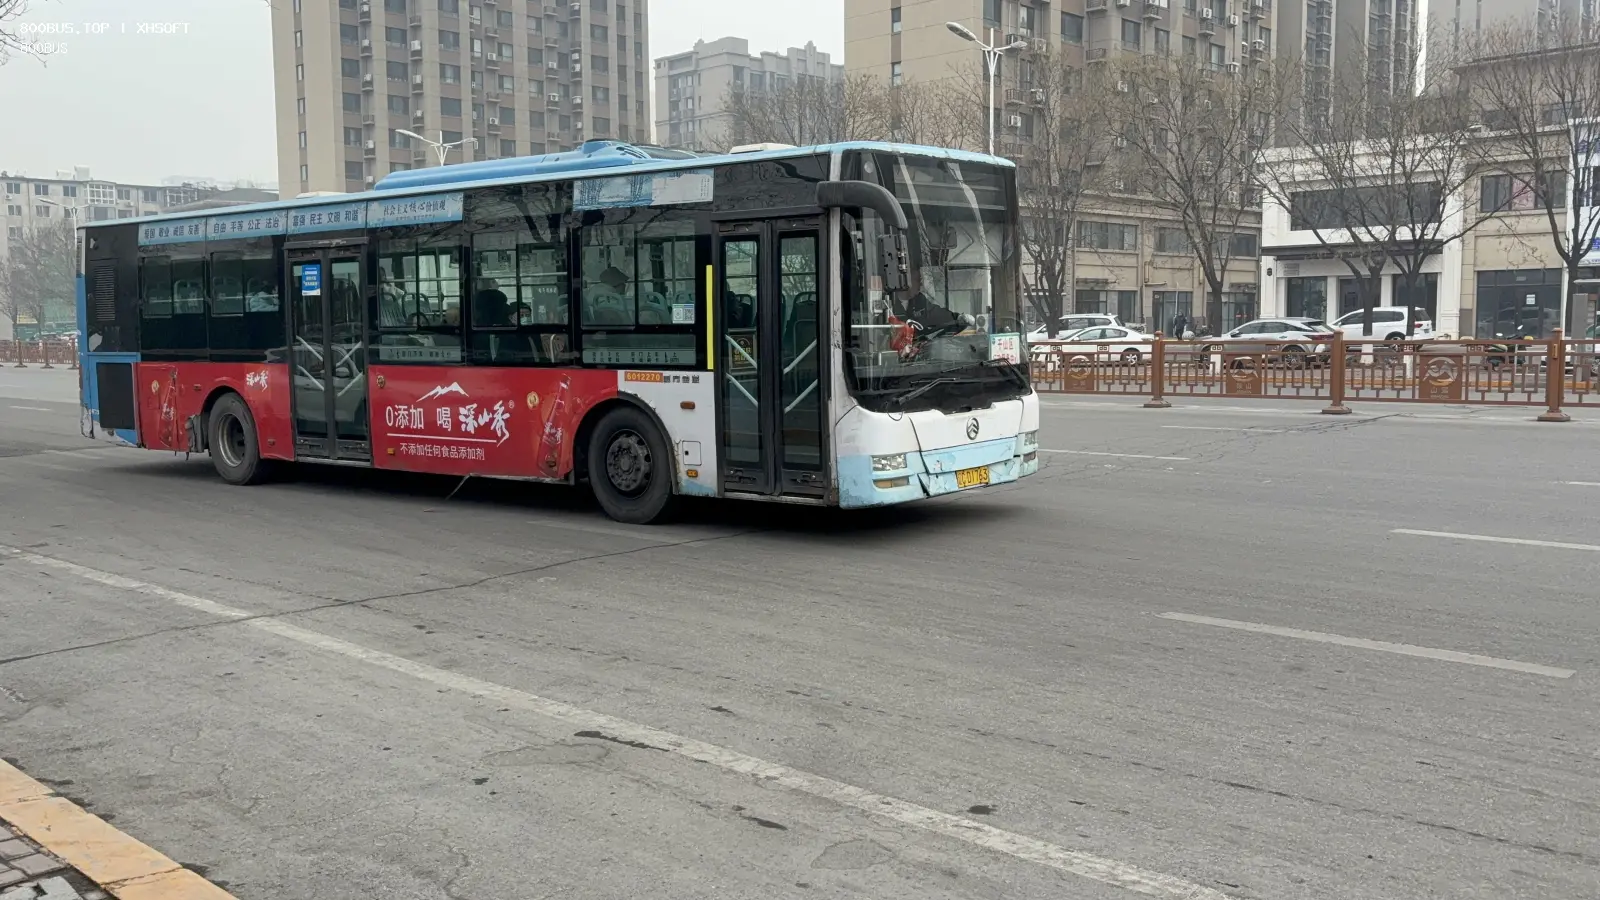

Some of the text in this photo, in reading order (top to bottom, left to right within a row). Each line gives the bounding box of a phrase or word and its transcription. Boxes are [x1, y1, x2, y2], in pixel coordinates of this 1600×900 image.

[383, 200, 446, 216] 社会主义核心价值观
[213, 216, 279, 233] 自由 平等 公正 法治
[292, 208, 358, 227] 富强 民主 文明 和谐
[158, 226, 170, 237] 敬业
[188, 224, 200, 235] 友善
[626, 372, 660, 382] 6012270
[385, 404, 424, 430] 0添加
[436, 407, 452, 432] 喝
[399, 442, 485, 461] 不添加任何食品添加剂
